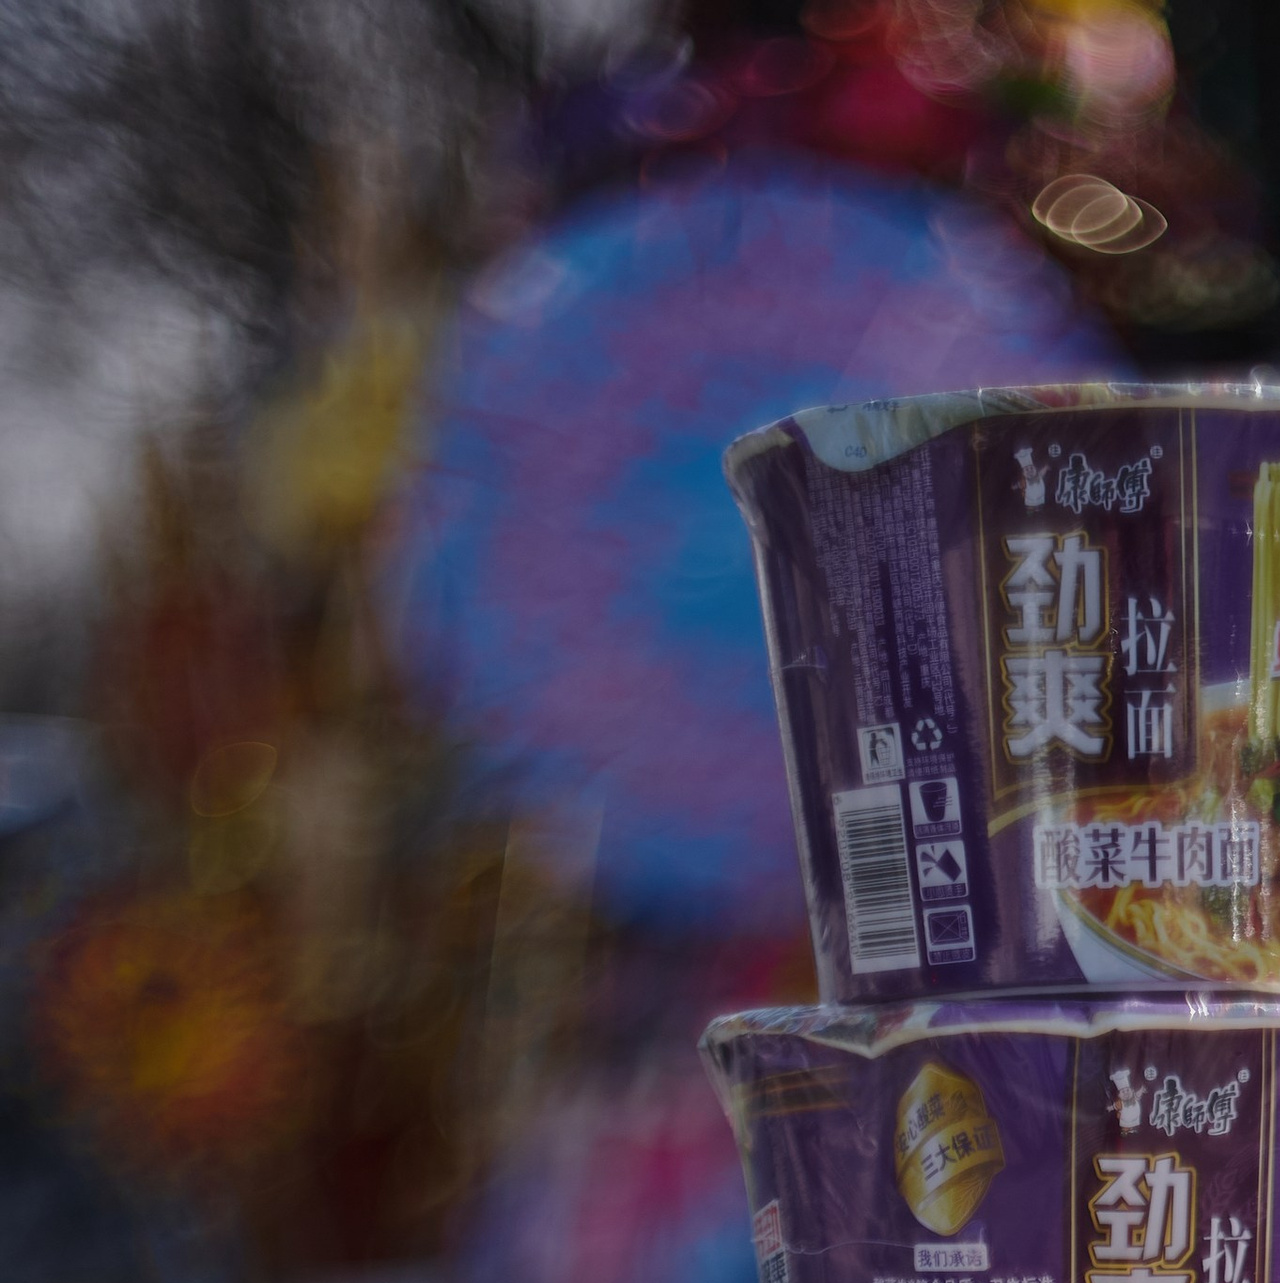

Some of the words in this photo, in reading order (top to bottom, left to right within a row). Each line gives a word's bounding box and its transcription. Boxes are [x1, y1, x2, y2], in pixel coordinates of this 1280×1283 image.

[1055, 452, 1151, 513] 康師傅
[1005, 534, 1105, 756] 劲爽
[1120, 597, 1177, 759] 拉面
[1039, 826, 1254, 883] 酸菜牛肉面
[1150, 1076, 1239, 1136] 康師傅
[921, 1123, 995, 1181] 三大保证
[917, 1250, 983, 1268] 我们承诺
